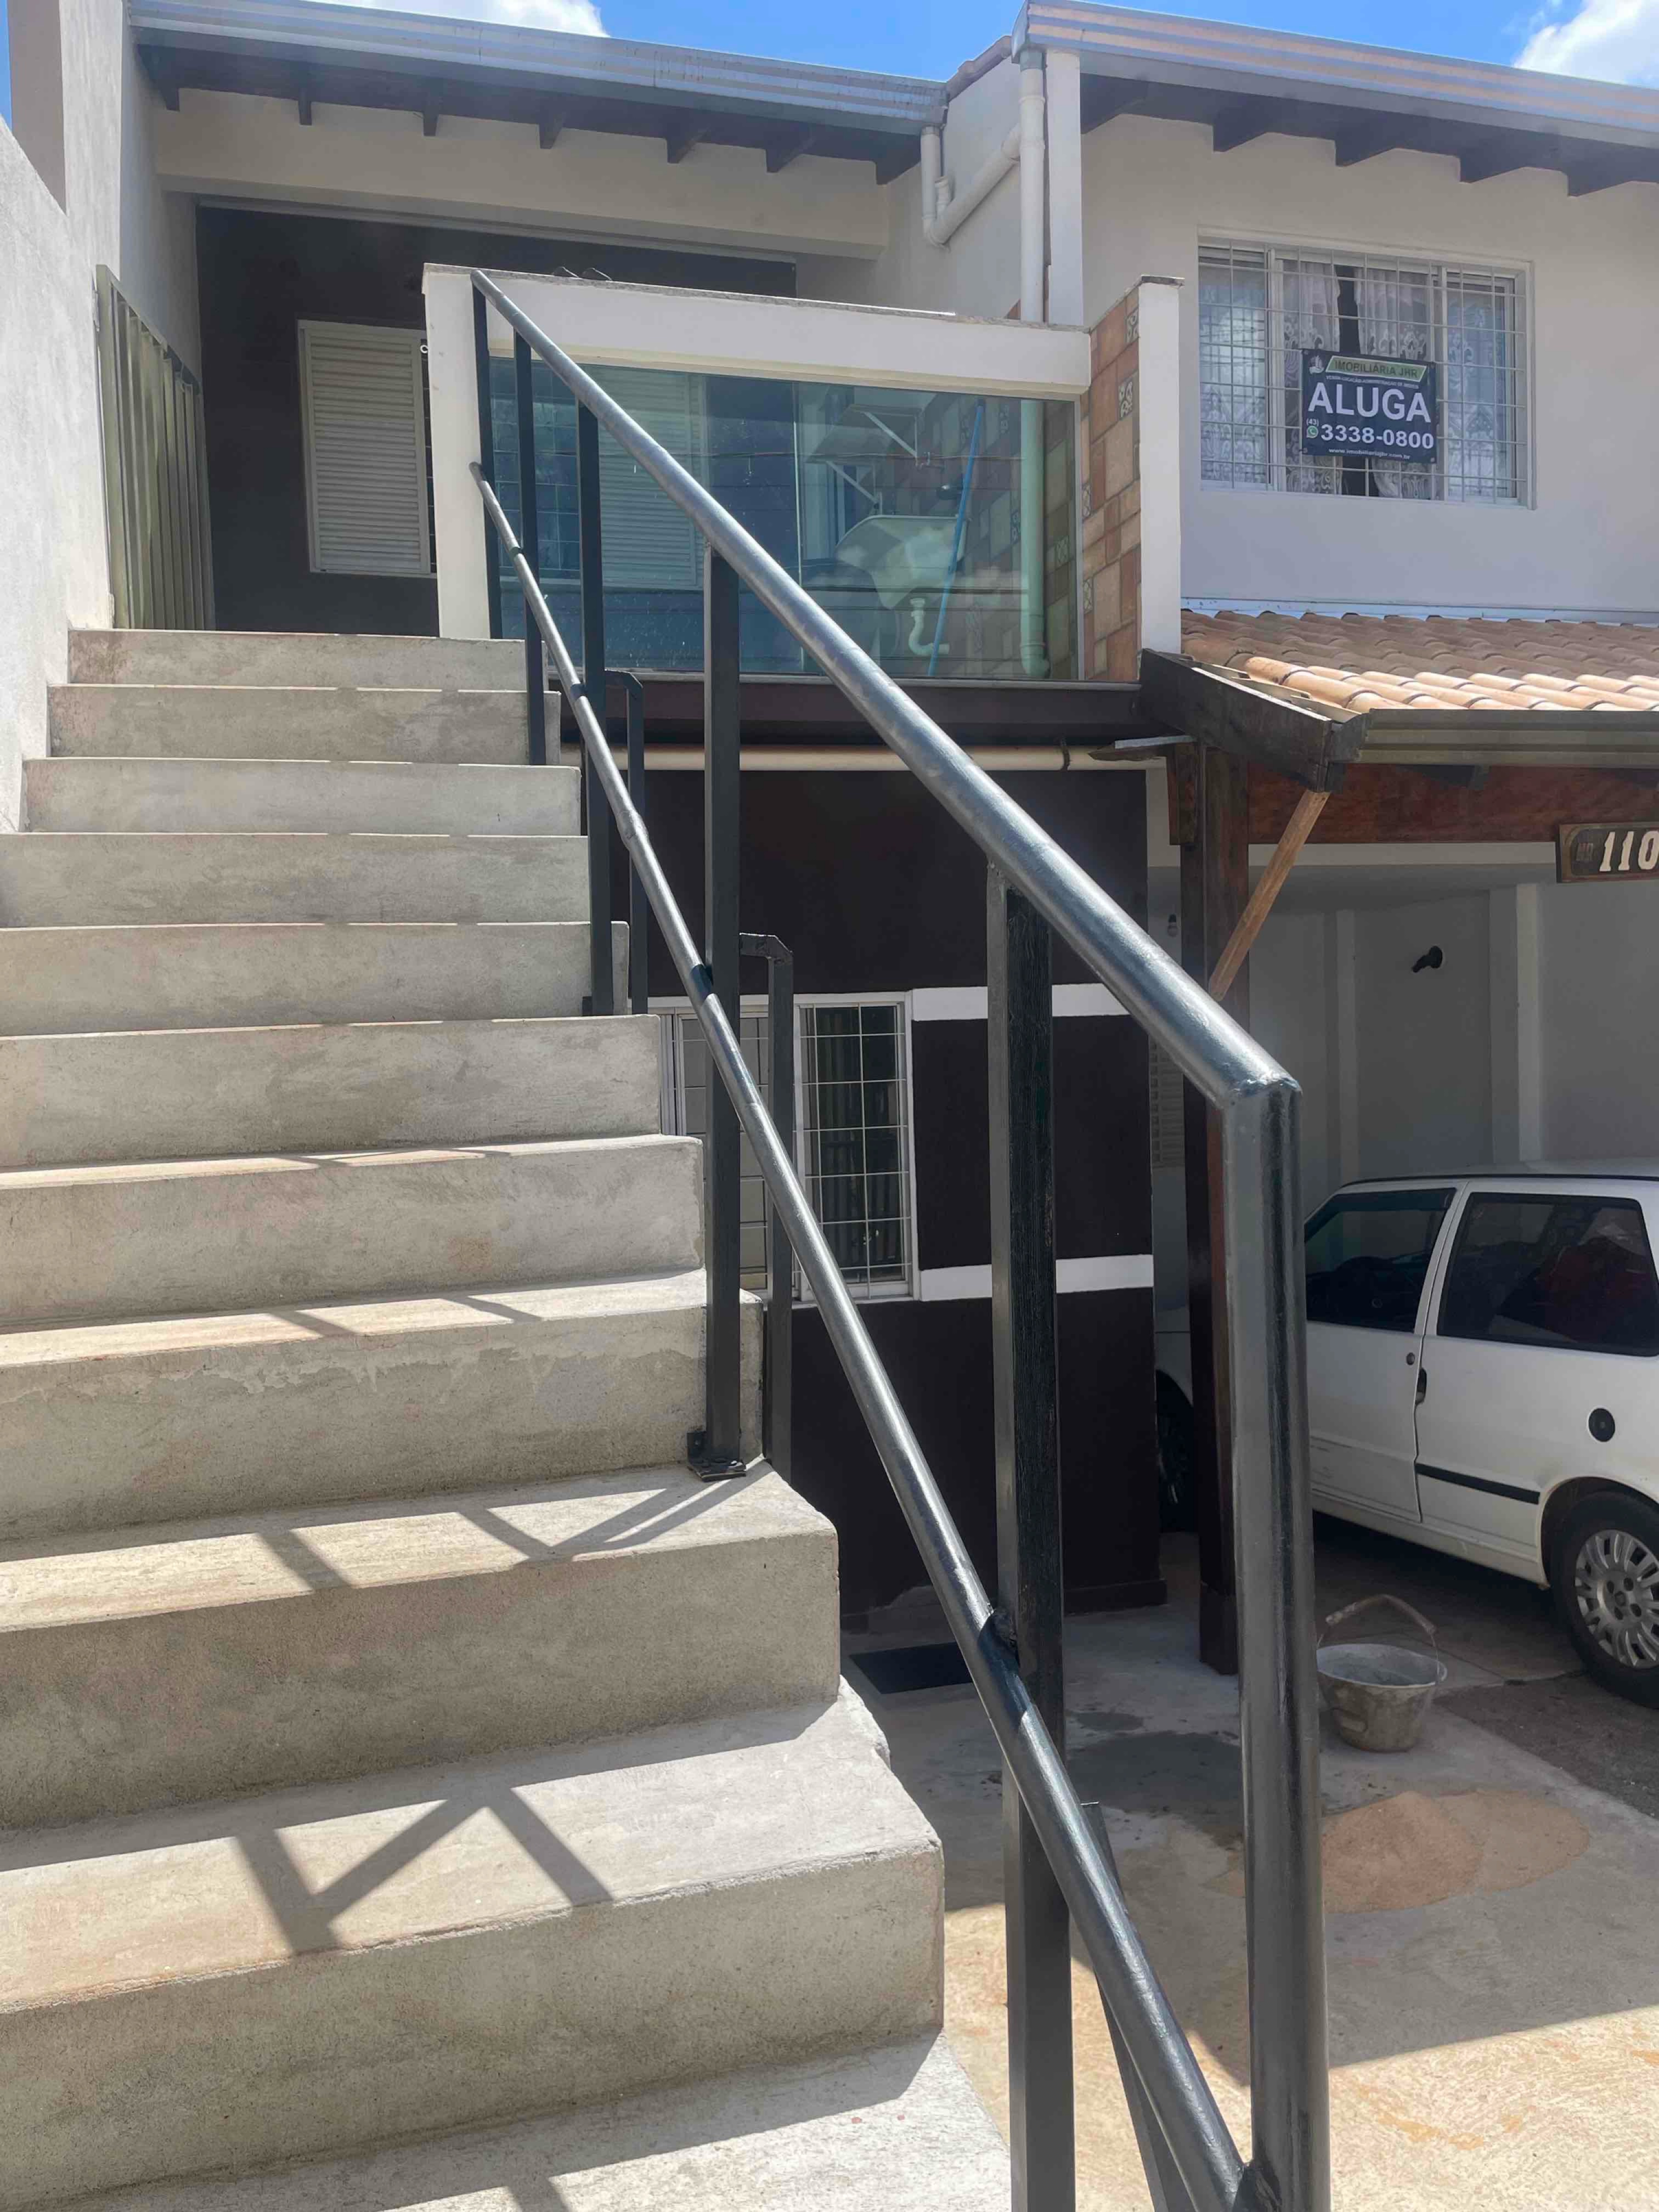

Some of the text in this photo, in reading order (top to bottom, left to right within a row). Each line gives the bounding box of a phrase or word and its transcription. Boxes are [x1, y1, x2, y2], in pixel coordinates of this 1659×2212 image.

[1400, 366, 1418, 378] JHR
[1308, 382, 1431, 422] ALUGA
[1306, 418, 1319, 427] (43)
[1321, 424, 1434, 449] 3338-0800
